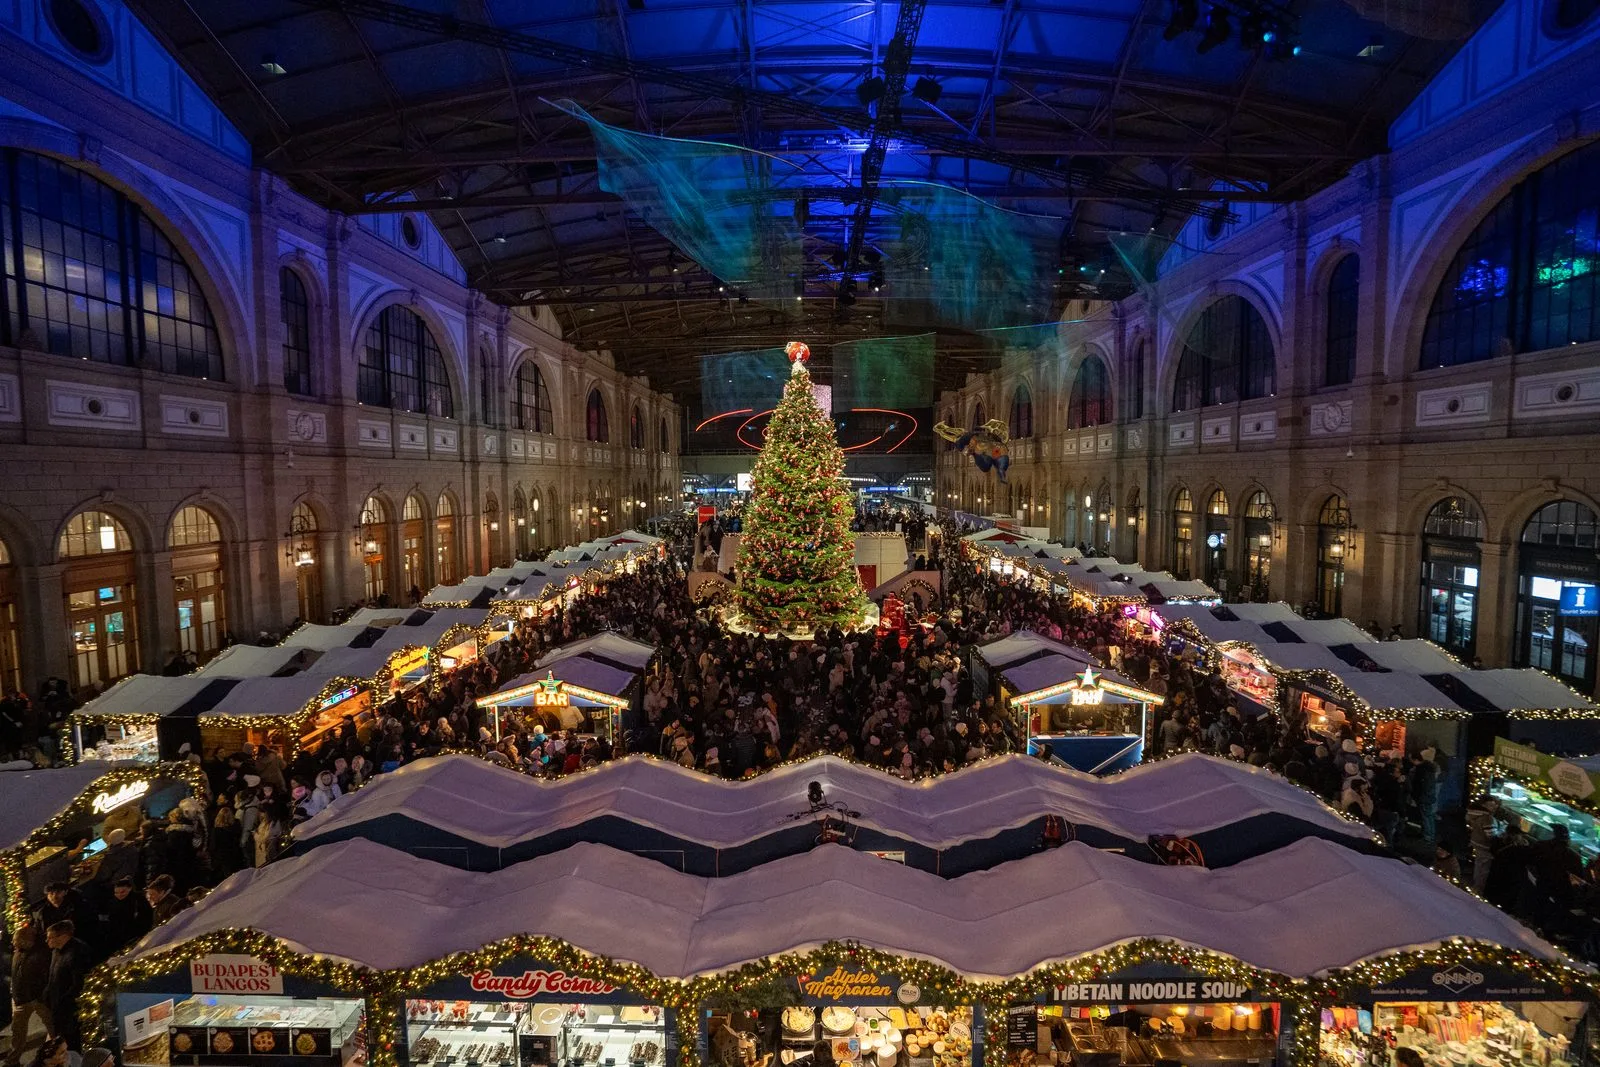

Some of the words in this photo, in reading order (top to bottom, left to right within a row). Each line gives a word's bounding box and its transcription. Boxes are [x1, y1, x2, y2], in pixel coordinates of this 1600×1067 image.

[536, 692, 568, 706] BAR
[193, 963, 278, 978] BUDAPEST
[204, 977, 270, 991] LANGOS
[472, 970, 543, 997] Candy
[545, 971, 616, 993] Corner
[1432, 972, 1484, 985] ONNO
[804, 981, 892, 1000] Magronen
[1129, 982, 1197, 1000] NOODLE
[1201, 981, 1248, 999] SOUP
